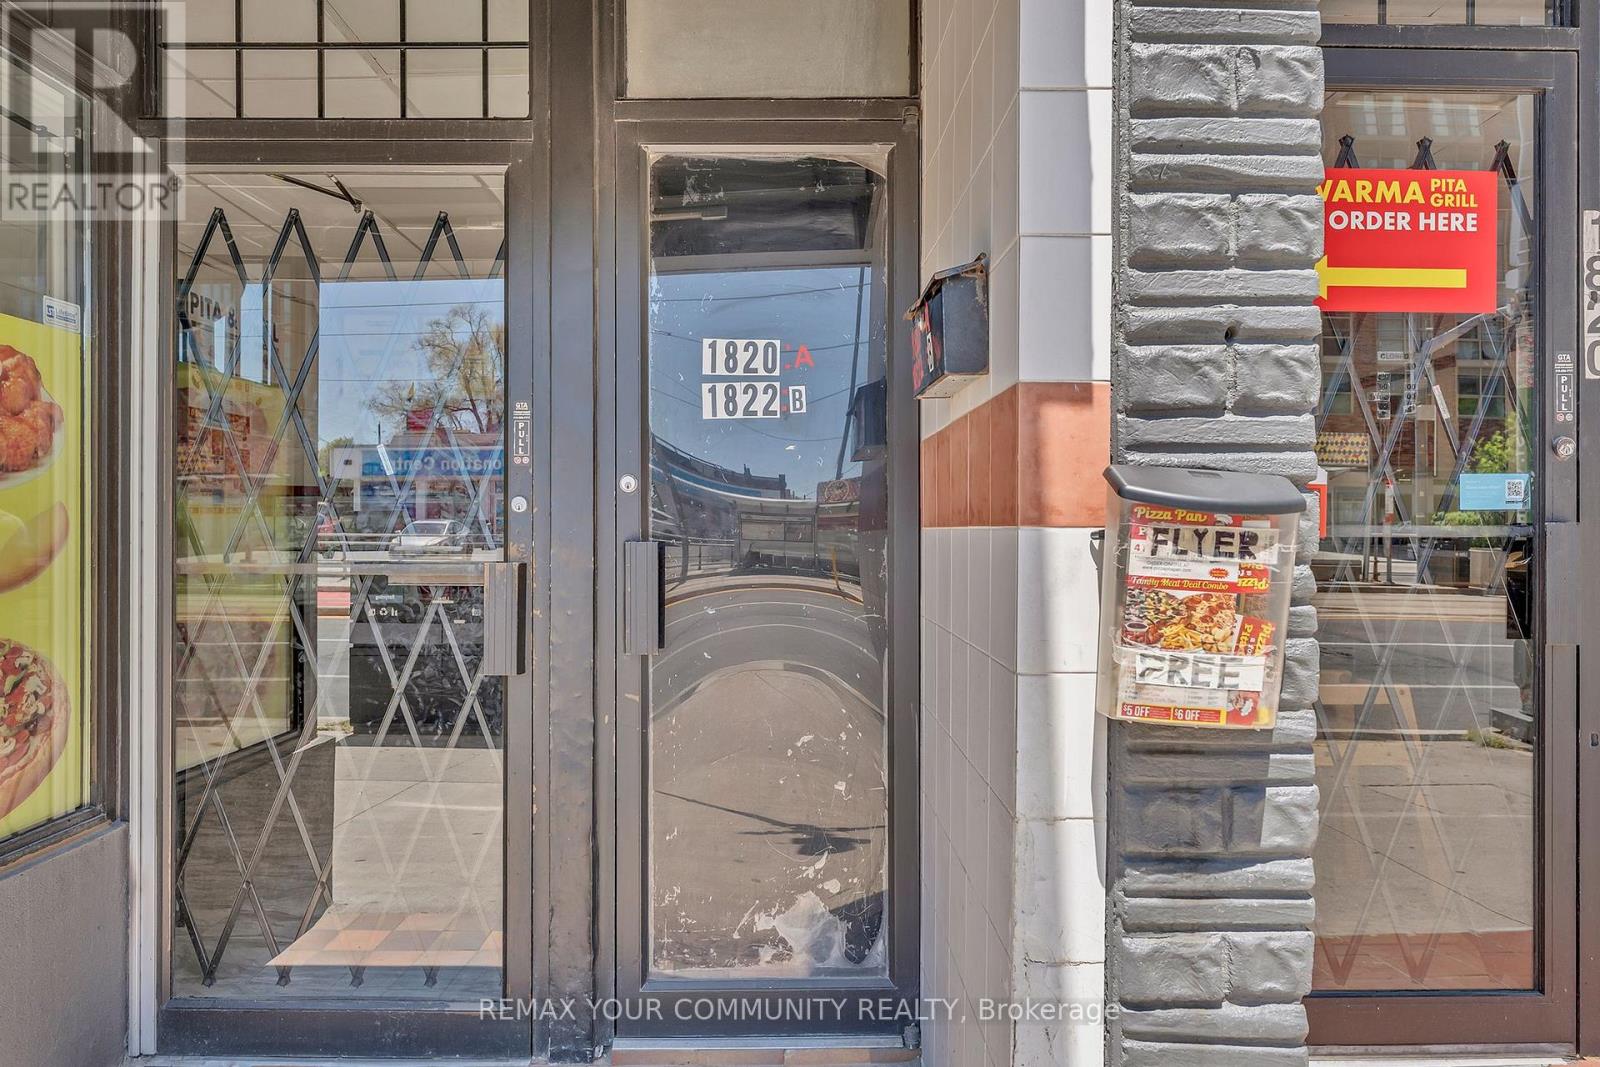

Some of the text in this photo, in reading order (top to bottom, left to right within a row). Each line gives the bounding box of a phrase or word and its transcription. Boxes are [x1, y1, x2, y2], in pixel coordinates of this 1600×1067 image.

[1431, 178, 1467, 192] PITA
[1430, 193, 1478, 208] GRILL
[1329, 210, 1478, 232] ORDER HERE
[189, 291, 222, 320] PITA
[708, 340, 778, 374] 1820
[708, 383, 778, 418] 1822
[791, 388, 804, 412] B
[1134, 506, 1208, 523] Pizza Pan
[1151, 527, 1259, 560] FLYER
[1160, 578, 1180, 587] Meal
[1181, 579, 1201, 588] Deal
[1202, 580, 1229, 590] Combo
[1123, 704, 1133, 716] $5
[1134, 706, 1151, 717] OFF
[1174, 708, 1184, 719] $6
[1185, 709, 1201, 721] OFF
